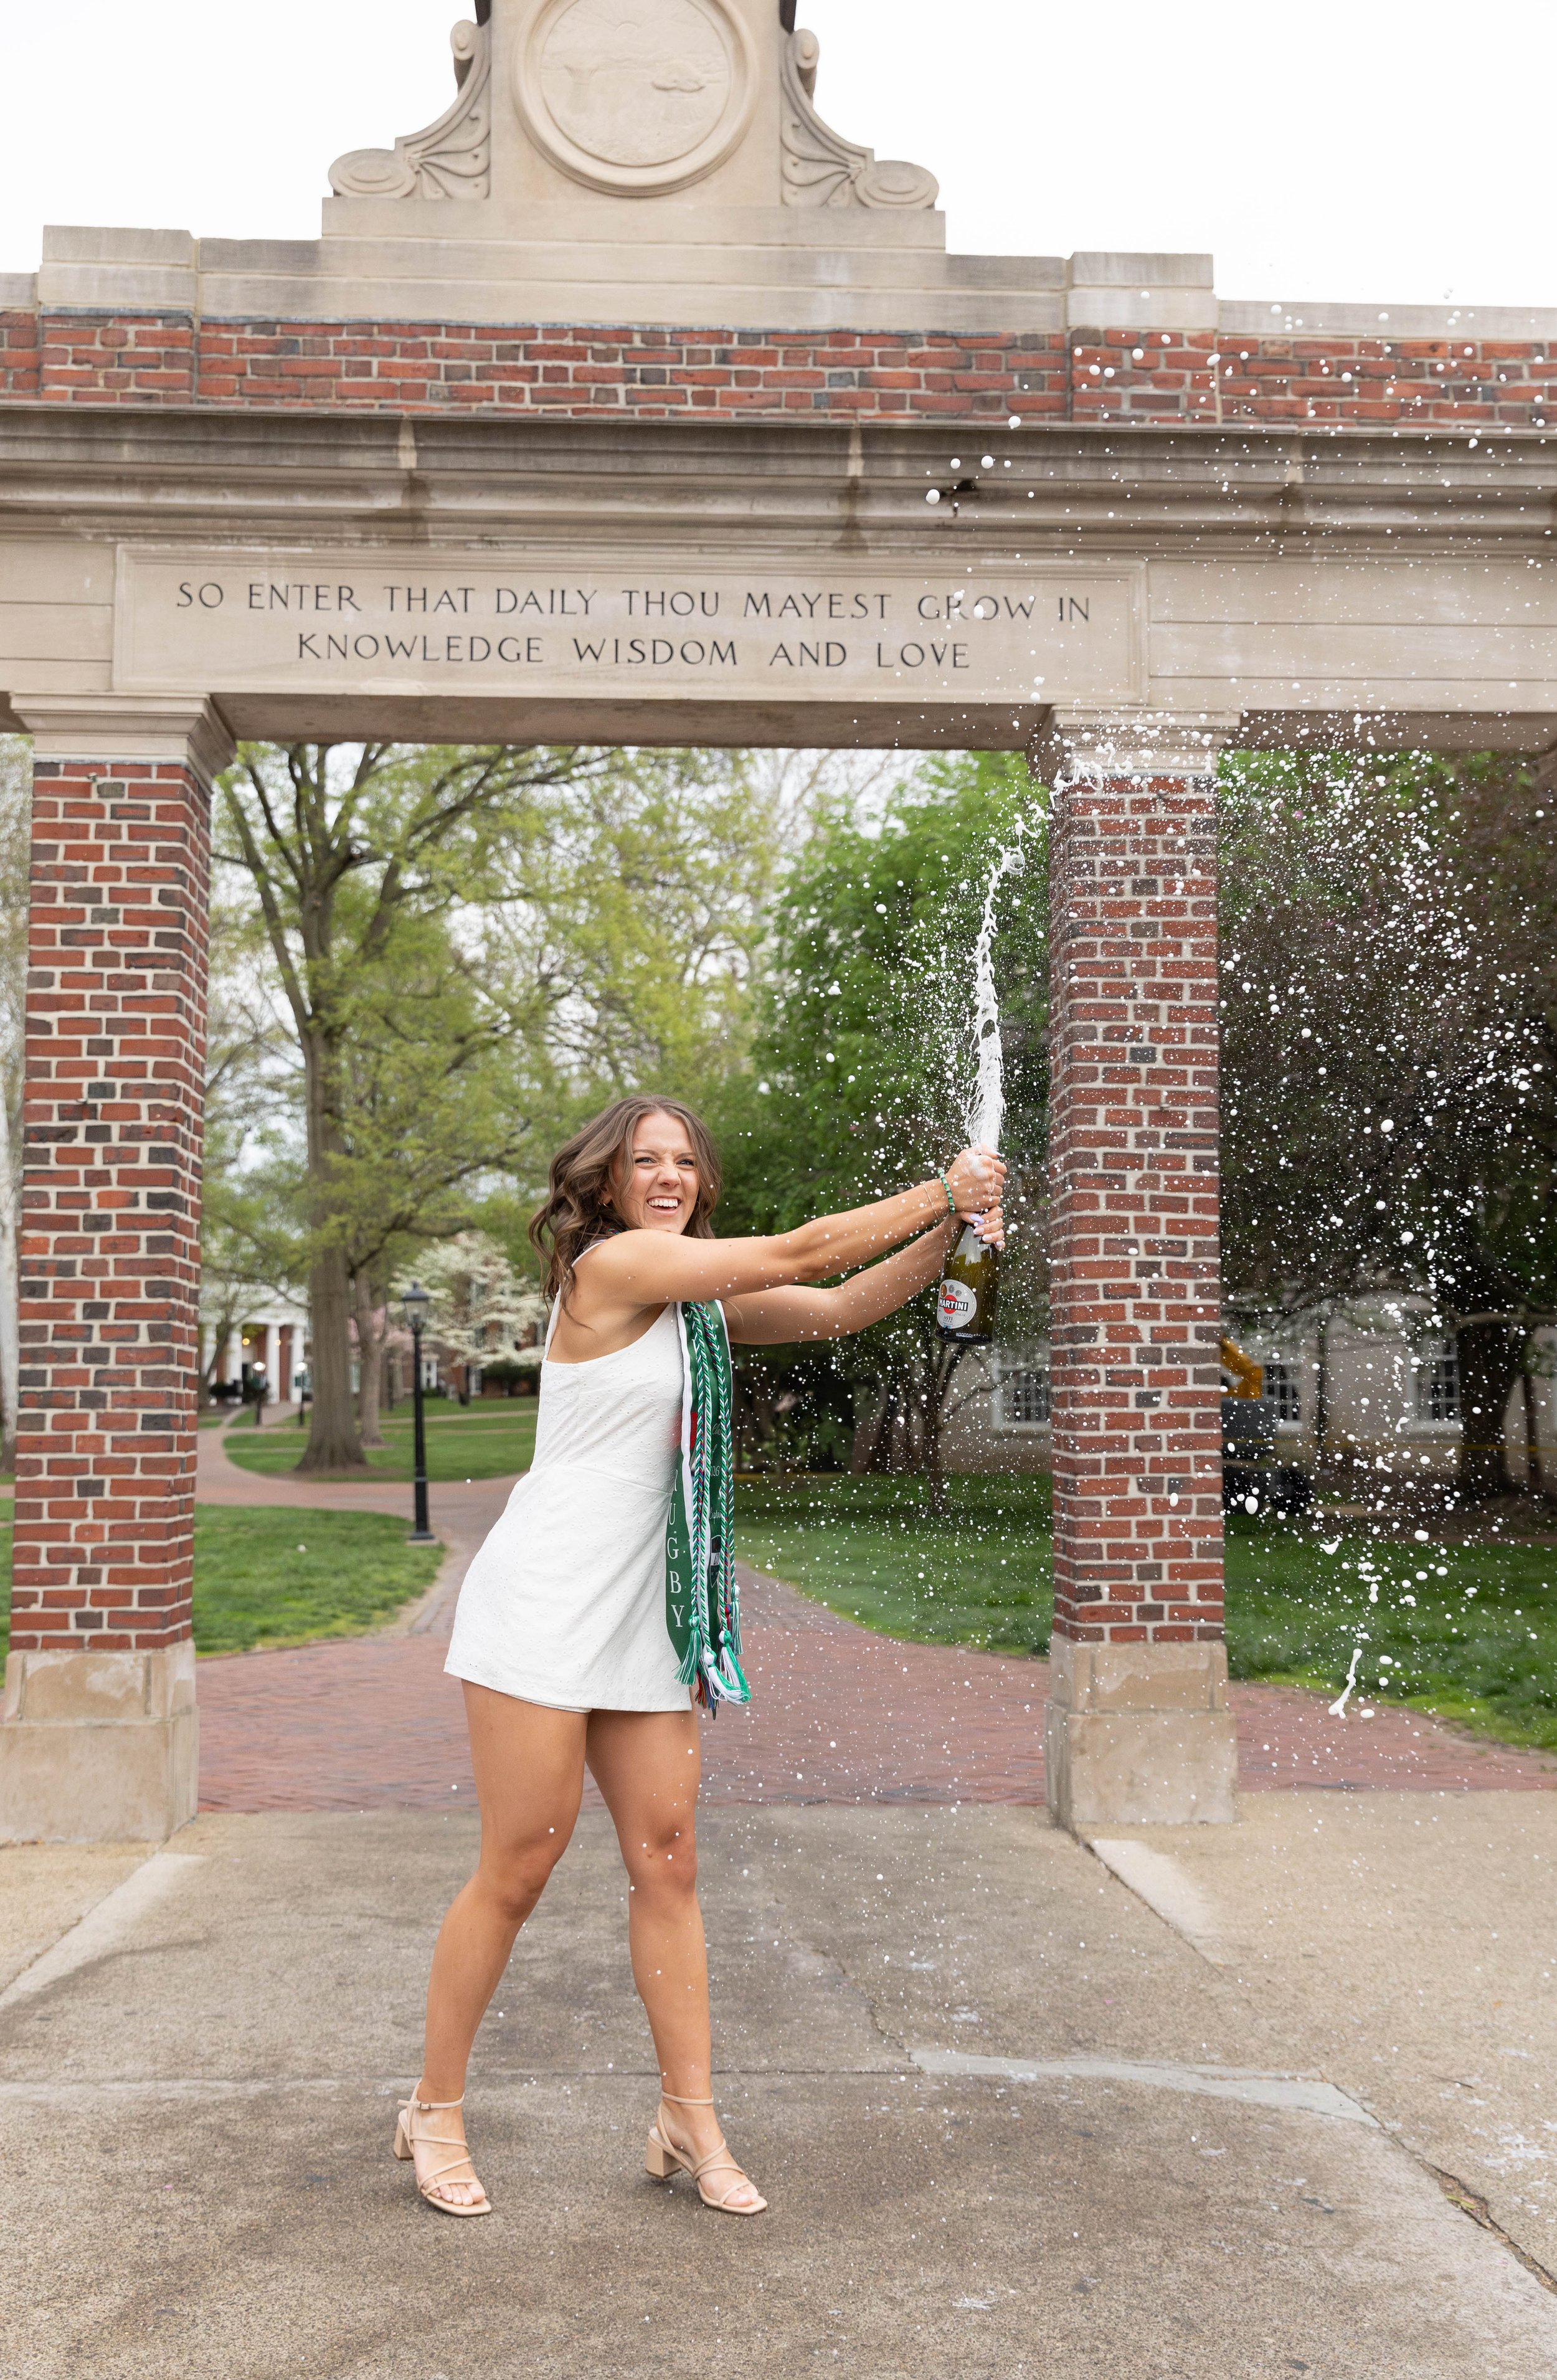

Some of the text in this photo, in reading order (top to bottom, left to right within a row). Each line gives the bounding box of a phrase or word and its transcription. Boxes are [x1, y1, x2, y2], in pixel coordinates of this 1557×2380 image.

[177, 582, 1089, 622] SO ENTER THAT DAILY THOU MAYEST GROW IN
[299, 633, 969, 668] KNOWLEDGE WISDOM AND LOVE
[939, 1298, 968, 1311] MARTINI
